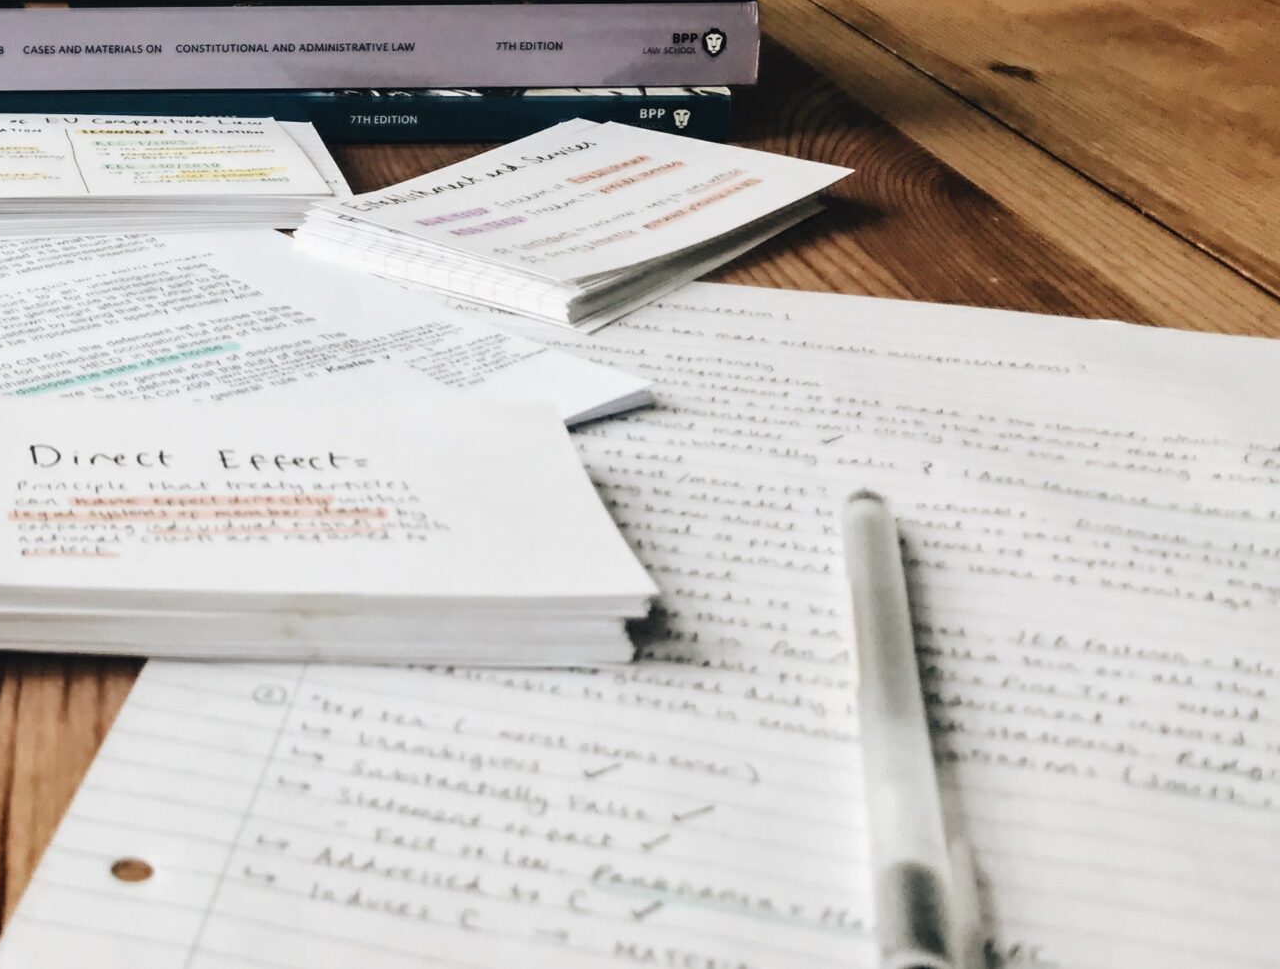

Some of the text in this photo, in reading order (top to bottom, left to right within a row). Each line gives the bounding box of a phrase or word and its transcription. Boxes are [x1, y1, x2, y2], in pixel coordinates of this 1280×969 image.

[672, 33, 699, 45] BPP
[22, 44, 162, 55] CASES AND MATERIALS ON
[175, 42, 415, 54] CONSTITUTIONAL AND ADMINISTRATIVE LAW
[495, 40, 564, 52] 7TH EDITION
[642, 46, 697, 55] LAW SCHOOL
[639, 108, 665, 119] BPP
[45, 117, 78, 125] EU
[92, 117, 206, 127] Competition
[218, 118, 262, 126] Law
[350, 114, 418, 125] 7TH EDITION
[341, 142, 597, 212] Establishment and Services
[29, 444, 173, 469] Direct
